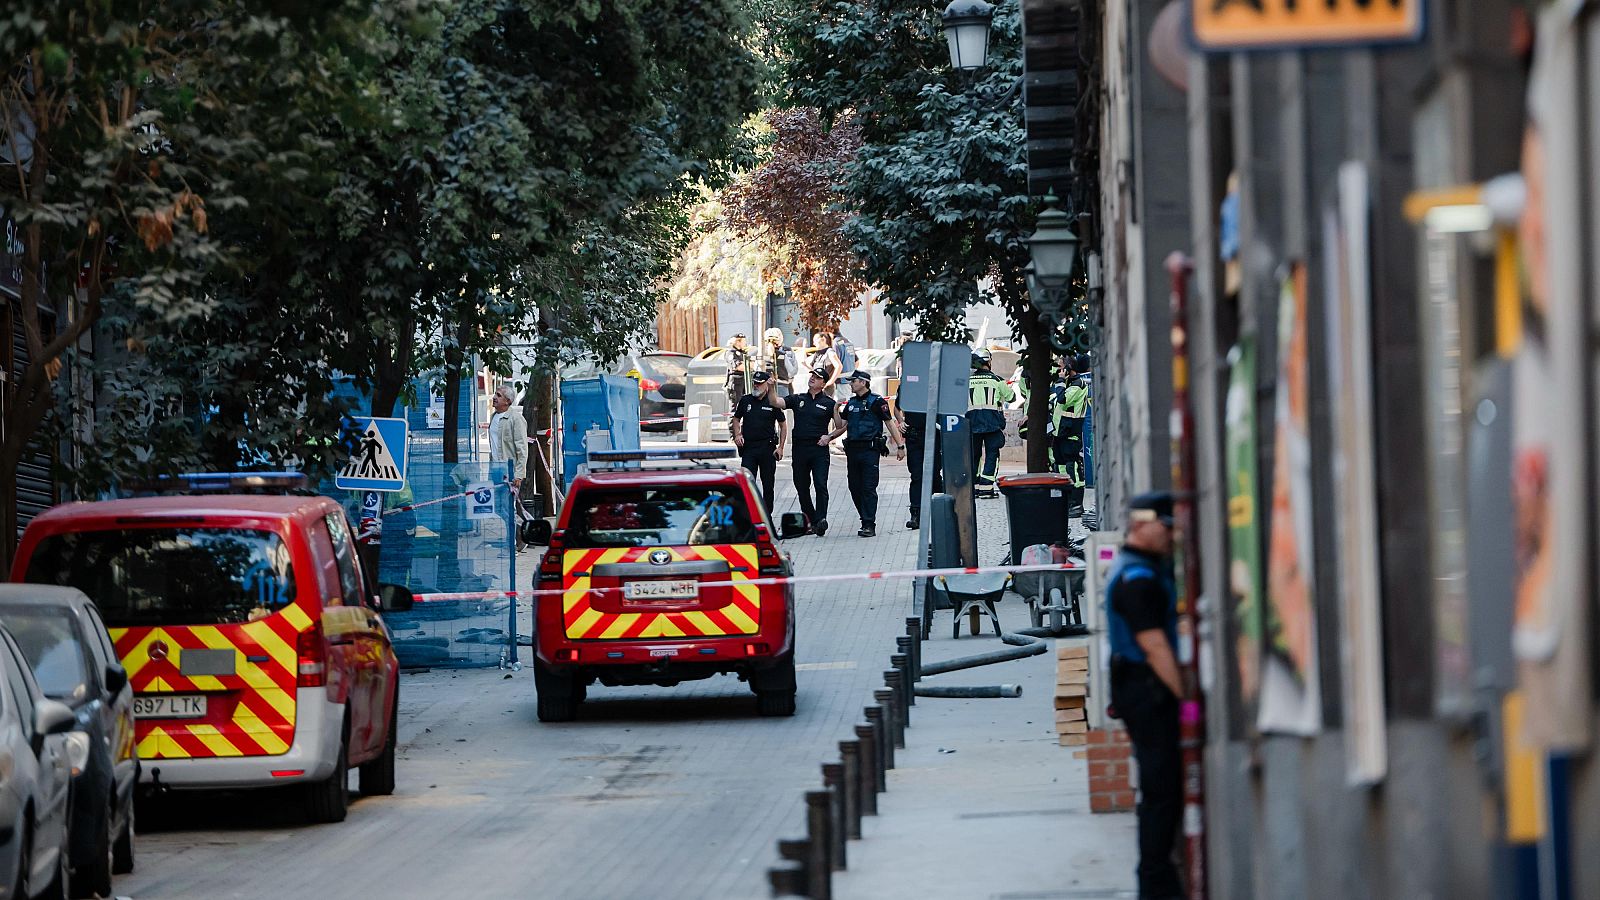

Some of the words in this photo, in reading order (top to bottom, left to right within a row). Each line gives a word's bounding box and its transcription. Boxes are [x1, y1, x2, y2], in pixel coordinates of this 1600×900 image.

[946, 415, 959, 432] P
[709, 504, 734, 526] 112
[257, 571, 289, 604] 112
[133, 698, 164, 714] 697
[170, 697, 201, 713] LTK
